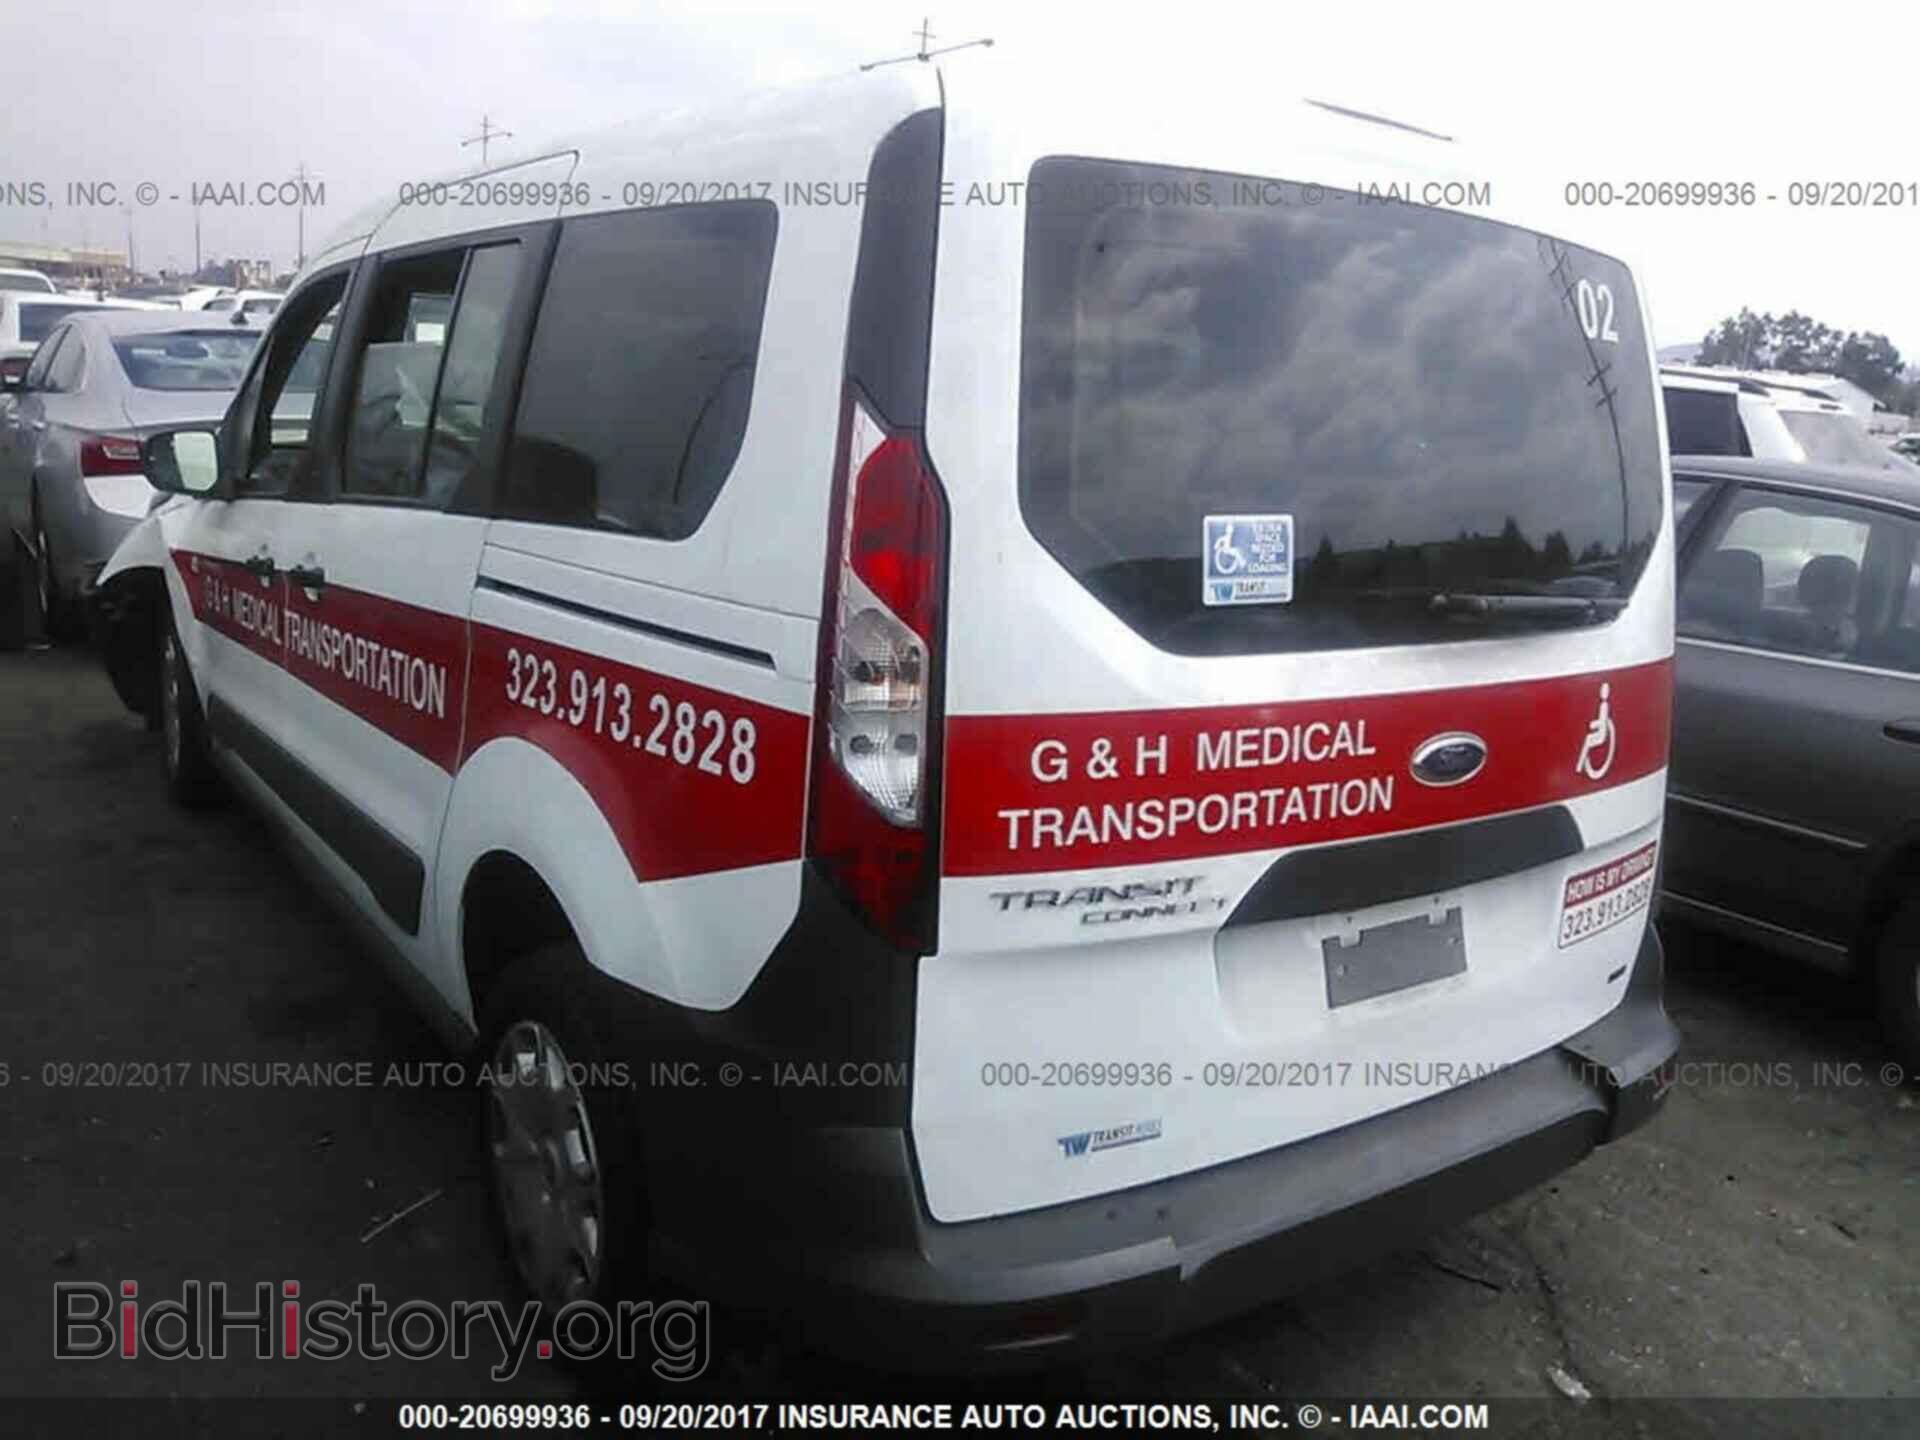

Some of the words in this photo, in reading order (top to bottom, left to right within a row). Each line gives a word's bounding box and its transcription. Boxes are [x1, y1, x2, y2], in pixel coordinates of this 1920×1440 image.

[1578, 279, 1619, 342] 02
[283, 610, 446, 719] TRANSPORTATION
[506, 648, 756, 785] 323.913.2828
[1030, 739, 1068, 782] G
[1086, 737, 1119, 779] &
[1135, 735, 1168, 776] H
[1197, 720, 1377, 771] MEDICAL
[998, 775, 1394, 851] TRANSPORTATION
[989, 876, 1206, 912] TRANSIT
